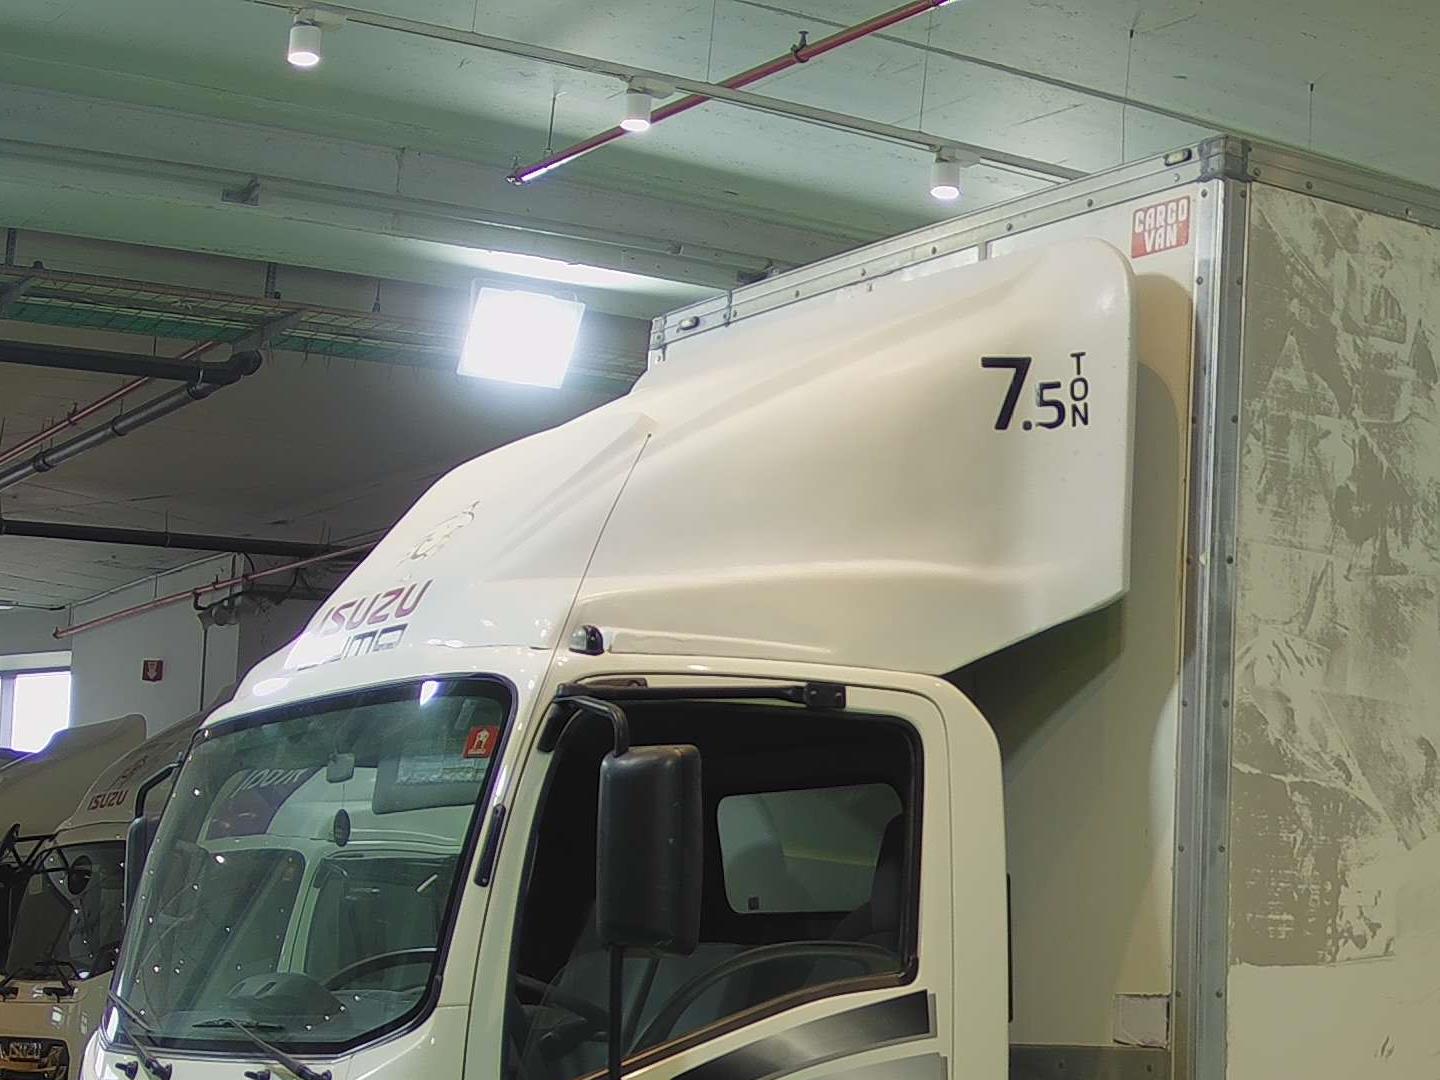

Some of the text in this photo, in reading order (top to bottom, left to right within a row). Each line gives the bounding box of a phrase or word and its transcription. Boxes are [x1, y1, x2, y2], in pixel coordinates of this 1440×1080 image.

[1135, 199, 1188, 233] CARGO
[1143, 221, 1179, 254] VAN
[981, 351, 1090, 431] 7.5 TON
[316, 578, 435, 637] ISUZU
[87, 790, 129, 811] ISUZU
